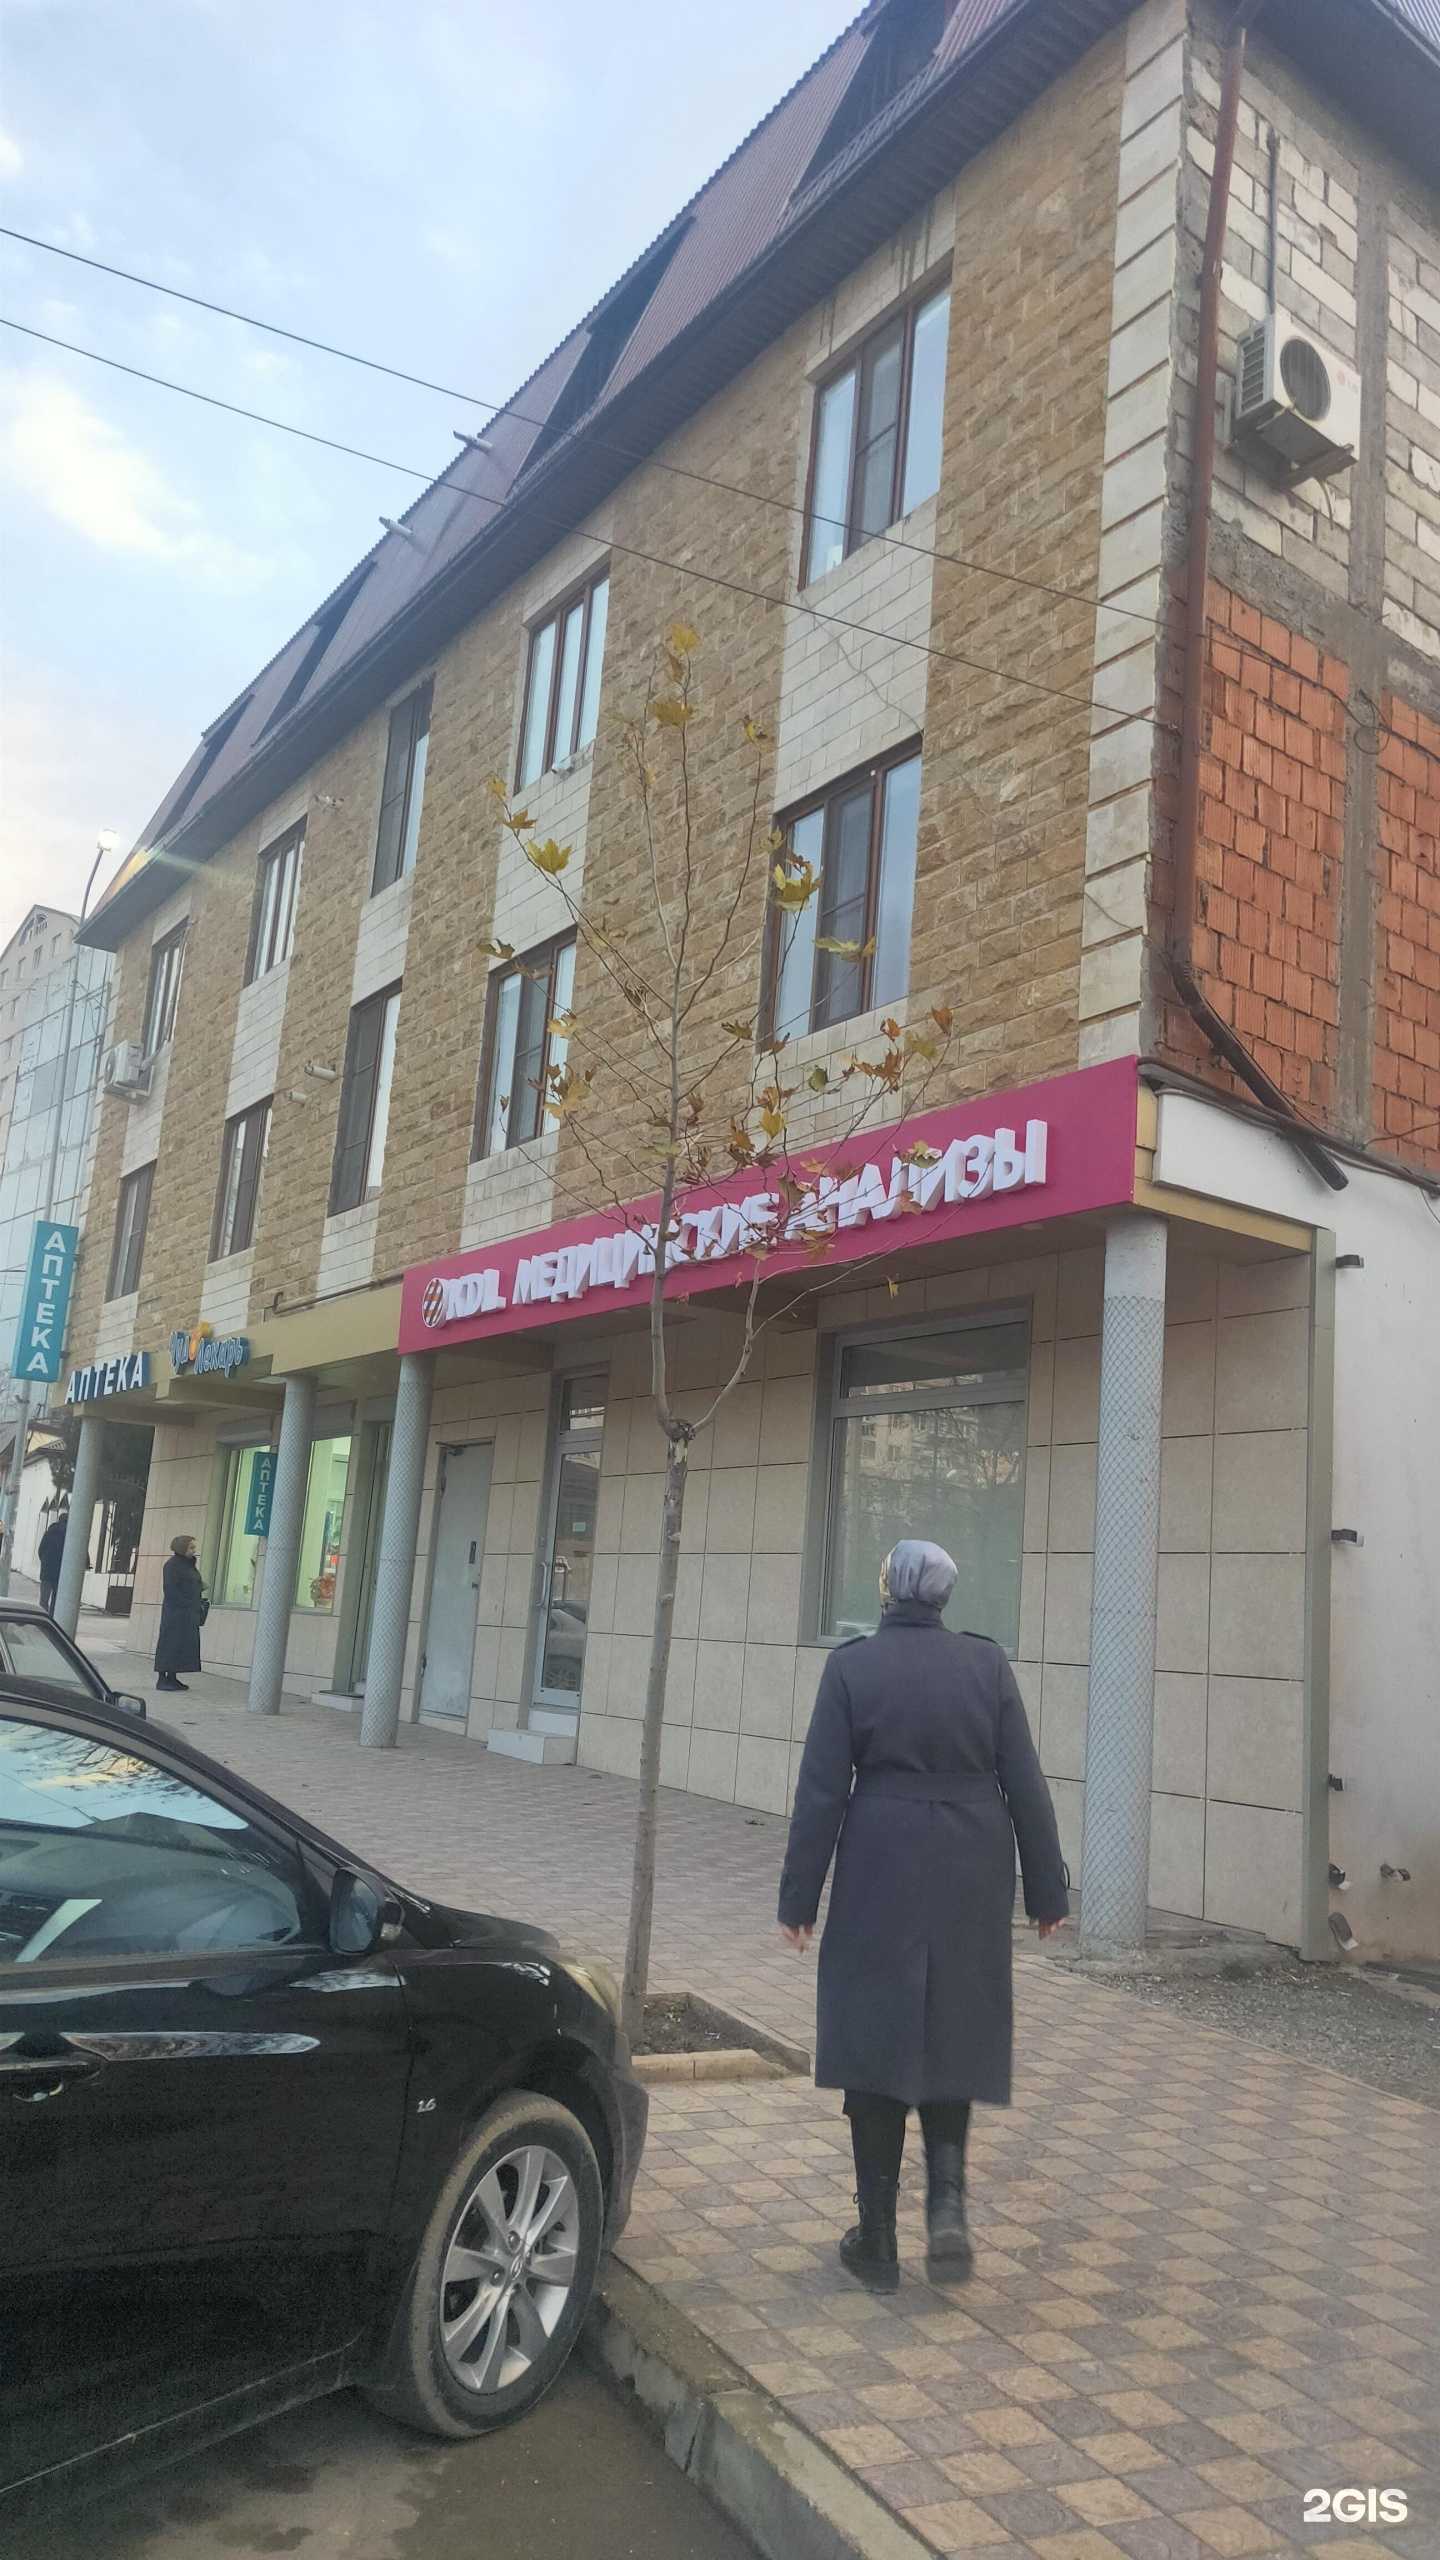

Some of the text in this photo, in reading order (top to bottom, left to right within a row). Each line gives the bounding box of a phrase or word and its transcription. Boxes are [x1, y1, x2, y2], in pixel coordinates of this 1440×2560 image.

[446, 1268, 506, 1321] KDL
[783, 1118, 1048, 1241] АНАЛИЗЫ
[26, 1230, 67, 1375] АПТЕКА
[64, 1350, 146, 1405] АПТЕКА
[253, 1457, 272, 1531] АПТЕКА
